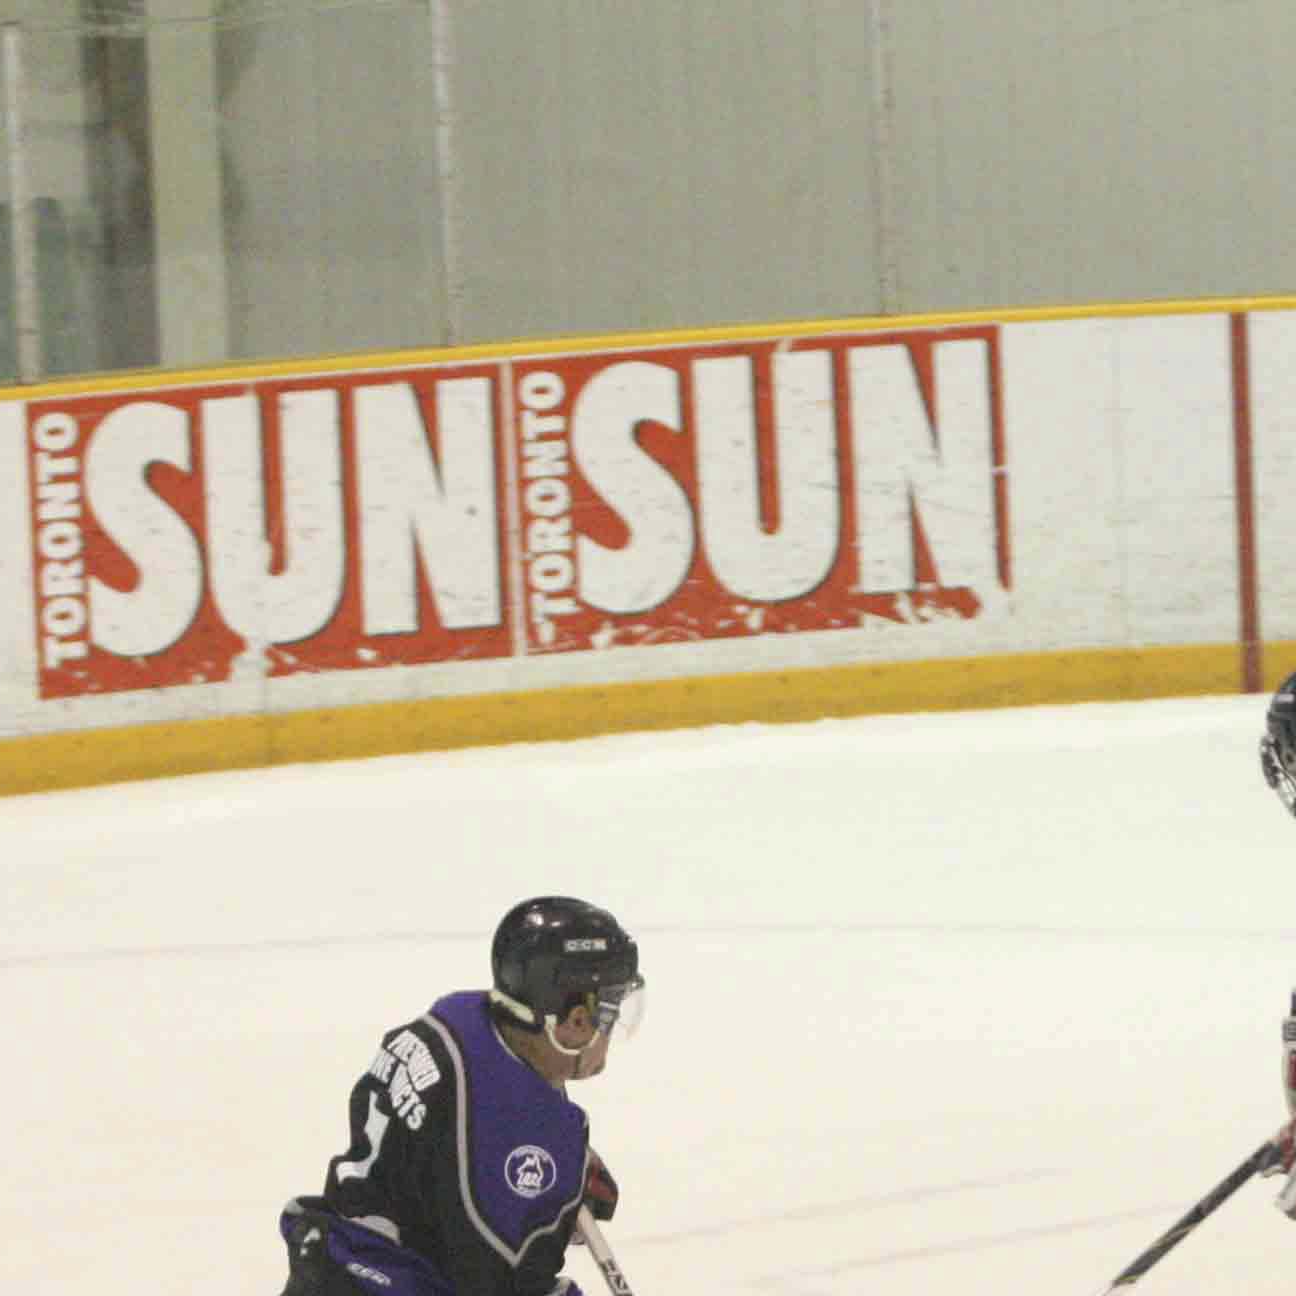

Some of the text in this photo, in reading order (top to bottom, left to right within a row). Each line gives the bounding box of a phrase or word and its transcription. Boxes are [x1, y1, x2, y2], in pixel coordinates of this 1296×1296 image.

[33, 412, 89, 670] TORONTO
[83, 376, 502, 658] SUN
[519, 370, 580, 628] TORONTO
[571, 338, 998, 616] SUN
